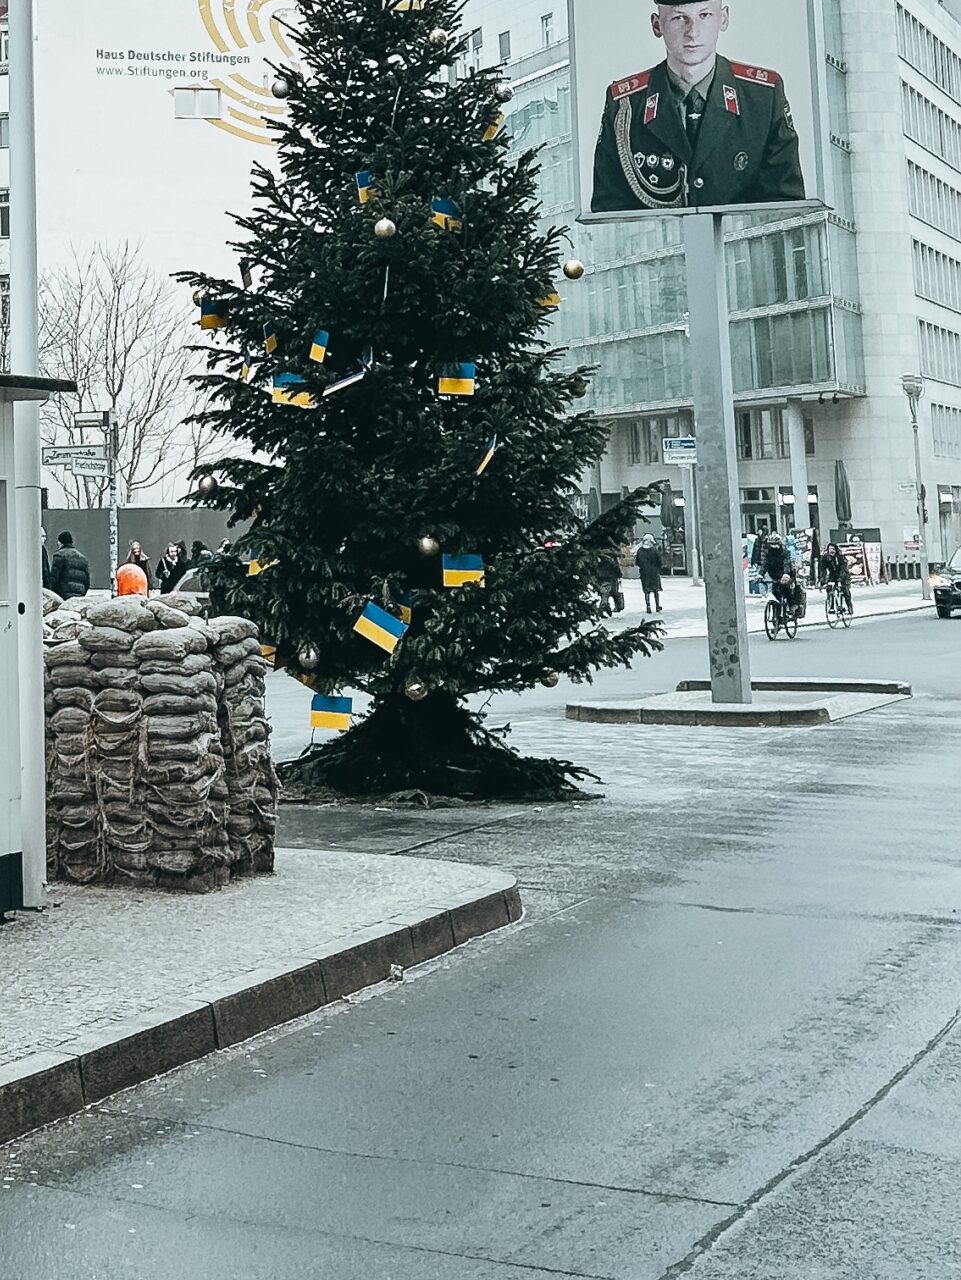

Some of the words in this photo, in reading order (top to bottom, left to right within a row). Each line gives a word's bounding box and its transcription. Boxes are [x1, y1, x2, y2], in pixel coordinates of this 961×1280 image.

[96, 49, 125, 60] Haus
[128, 50, 187, 62] Deutscher
[189, 51, 251, 66] Stiftungen
